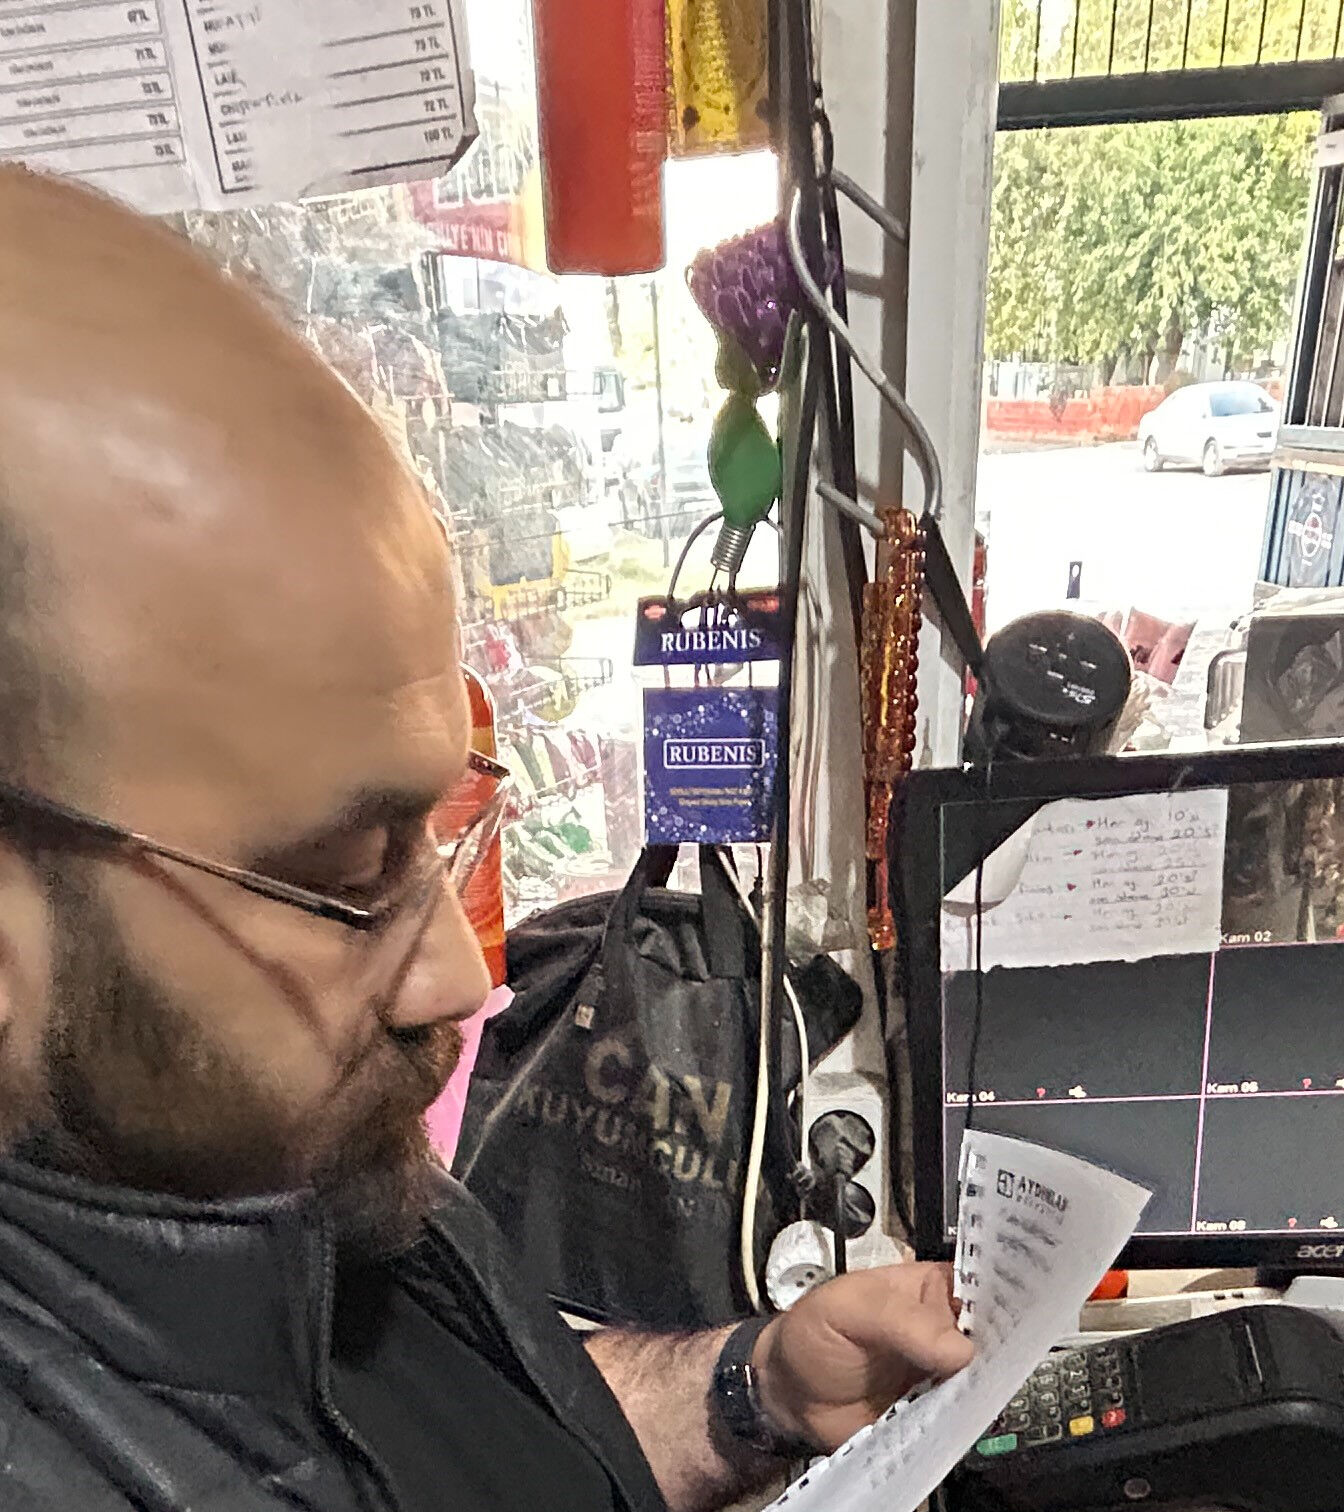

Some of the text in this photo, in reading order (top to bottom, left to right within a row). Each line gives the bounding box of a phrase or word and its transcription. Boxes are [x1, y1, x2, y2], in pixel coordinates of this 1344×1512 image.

[660, 628, 762, 653] RUBENIS
[668, 744, 757, 764] RUBENIS
[1221, 930, 1272, 945] Kam 02
[1206, 1081, 1239, 1095] Kam
[978, 1090, 996, 1102] 04
[1196, 1220, 1227, 1233] Kam
